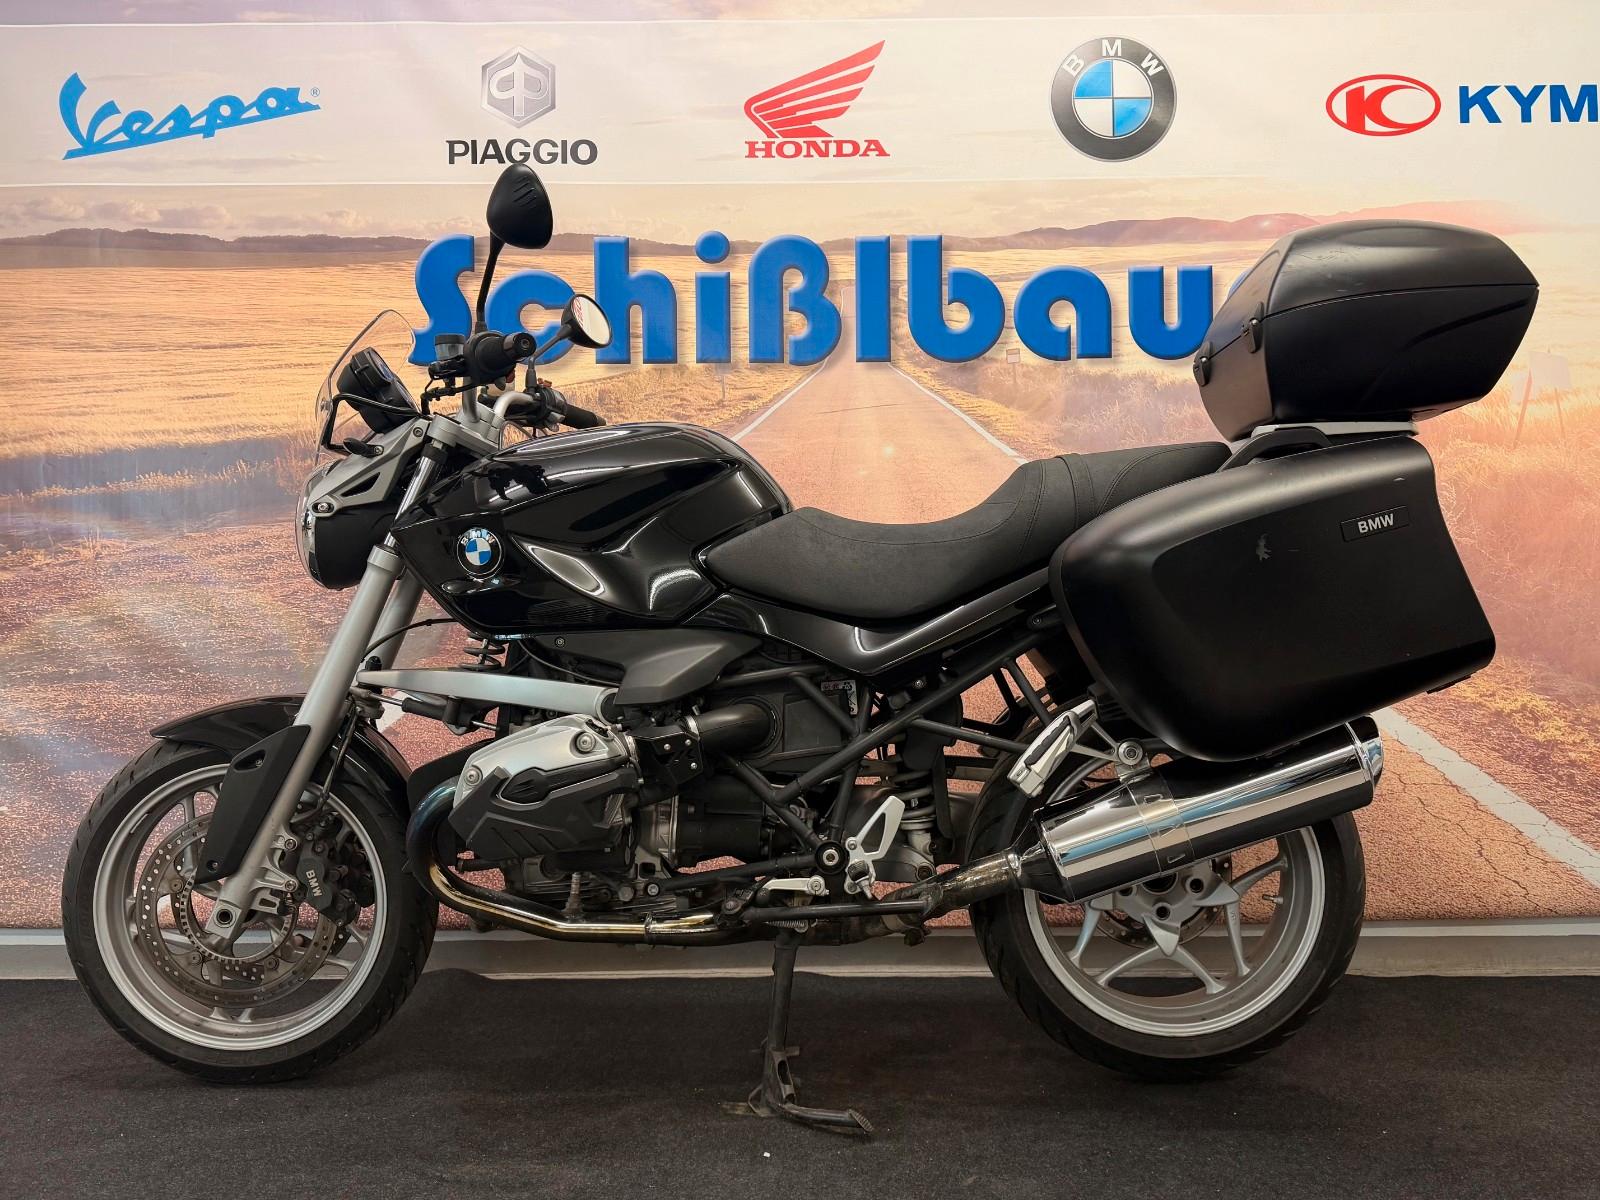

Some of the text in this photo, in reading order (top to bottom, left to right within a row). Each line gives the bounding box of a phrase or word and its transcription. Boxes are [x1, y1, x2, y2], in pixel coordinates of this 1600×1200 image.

[1062, 38, 1165, 78] BMW
[1458, 84, 1599, 124] KYM
[445, 138, 599, 165] PIAGGIO
[744, 139, 891, 159] HONDA
[407, 230, 1252, 367] Schißlbau
[1357, 513, 1395, 534] BMW
[460, 529, 496, 546] BMW
[305, 869, 323, 897] BMW
